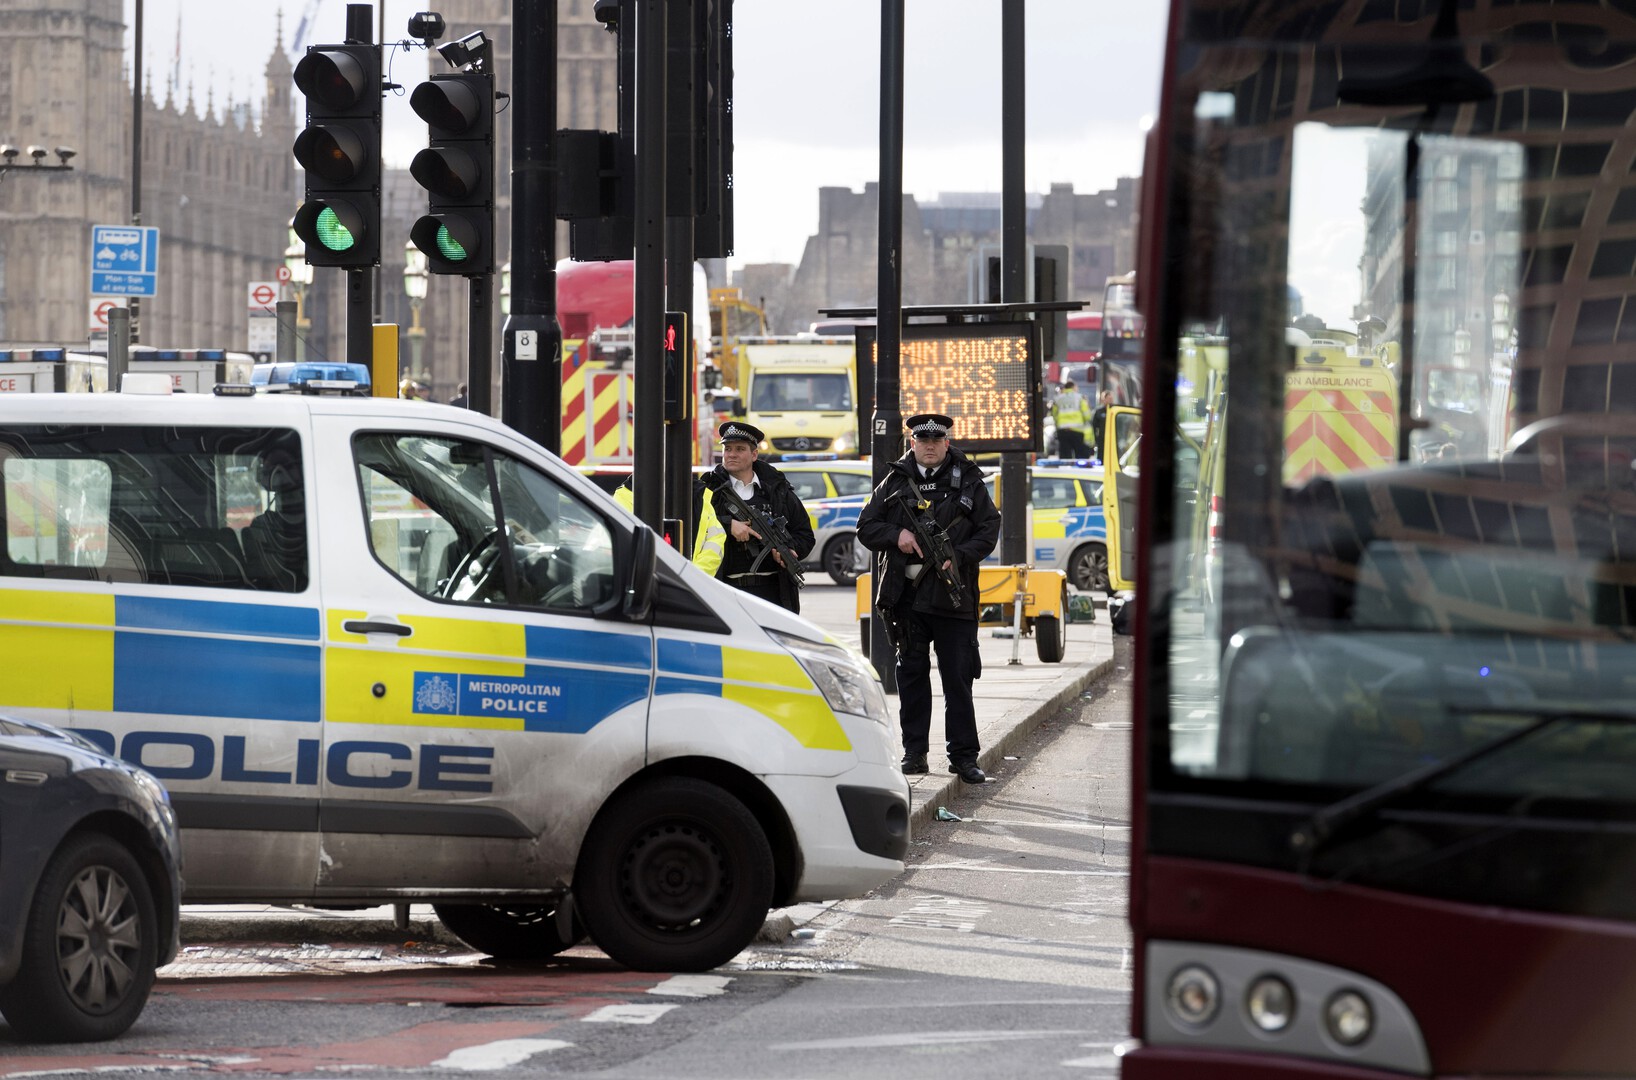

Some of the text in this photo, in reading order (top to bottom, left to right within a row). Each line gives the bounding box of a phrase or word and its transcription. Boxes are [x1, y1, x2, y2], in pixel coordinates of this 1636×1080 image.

[520, 332, 530, 346] 8
[945, 338, 1028, 364] BRIDGES
[901, 365, 996, 391] WORKS
[1304, 376, 1373, 387] AMBULANCE
[877, 421, 885, 432] 7
[954, 415, 1030, 440] DELAYS
[919, 482, 937, 491] POLICE
[468, 681, 561, 697] METROPOLITAN
[481, 697, 548, 713] POLICE
